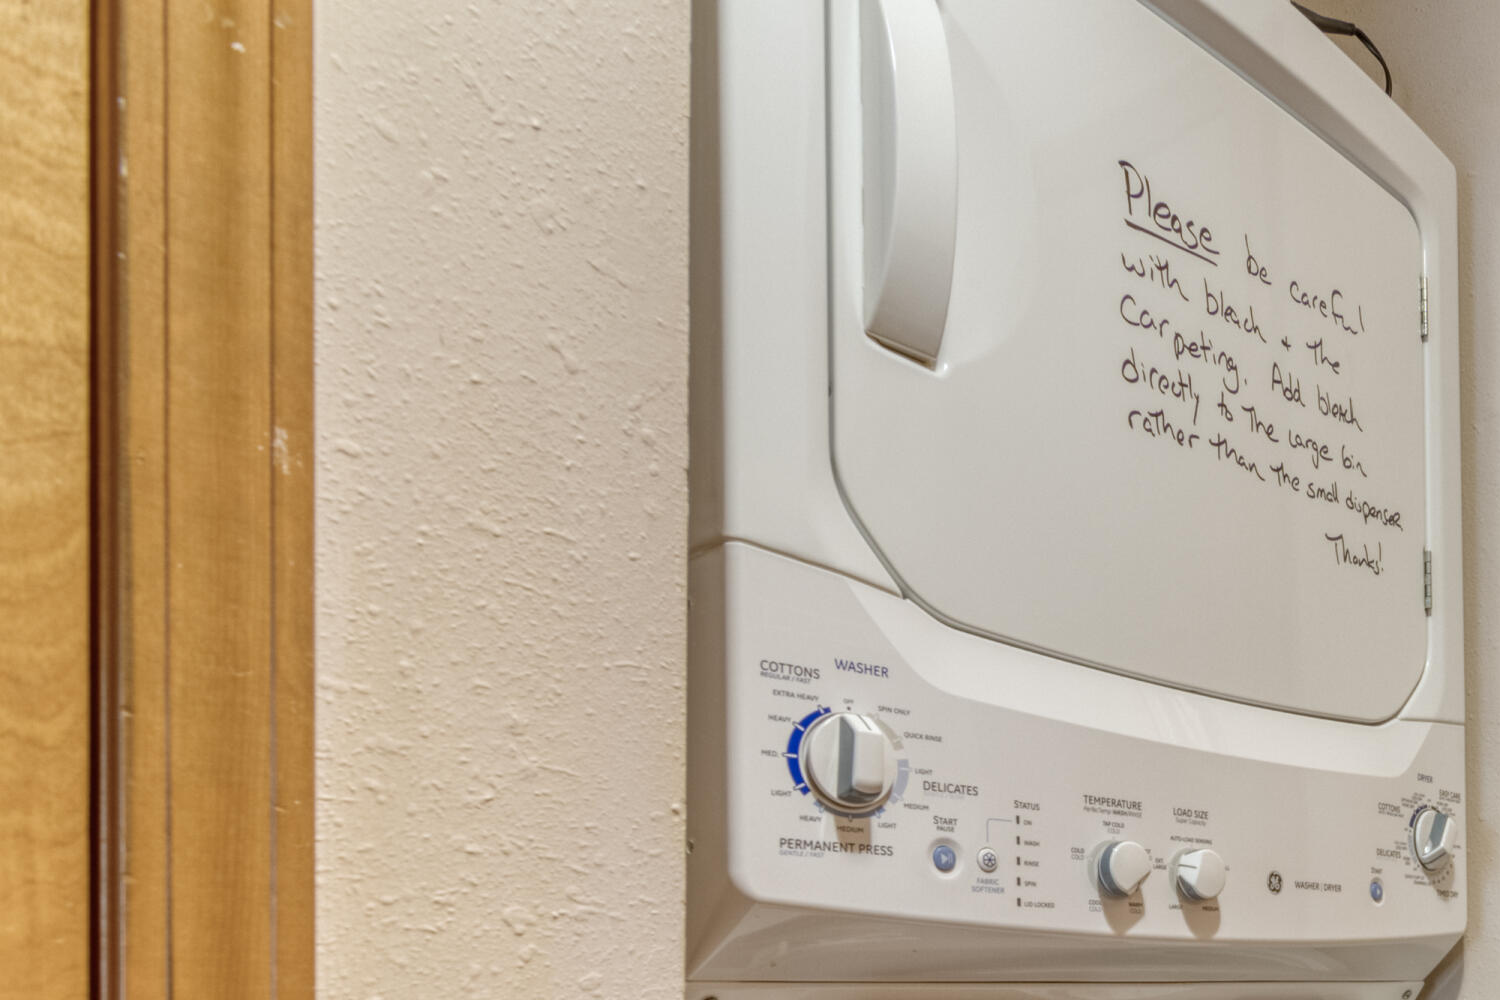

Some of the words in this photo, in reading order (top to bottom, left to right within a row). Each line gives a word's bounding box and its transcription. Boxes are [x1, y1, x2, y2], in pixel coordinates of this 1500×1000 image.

[1118, 160, 1220, 256] Please
[1244, 233, 1272, 285] be
[1290, 281, 1365, 335] careful
[1121, 253, 1189, 302] with
[1204, 278, 1267, 343] bleach
[1271, 362, 1306, 407] Add
[1316, 384, 1363, 432] bleach
[1121, 347, 1199, 425] directly
[1217, 391, 1234, 422] to
[1287, 429, 1333, 469] large
[1341, 445, 1367, 477] bin
[1128, 408, 1200, 448] rather
[1208, 432, 1266, 482] than
[1306, 481, 1339, 504] small
[1324, 532, 1384, 575] Thanks!
[760, 660, 820, 680] COTTONS
[834, 658, 889, 678] WASHER
[760, 671, 790, 681] REGULAR
[772, 689, 795, 698] EXTRA
[797, 691, 819, 701] HEAVY
[878, 705, 892, 713] SPIN
[893, 707, 911, 715] ONLY
[768, 714, 791, 722] HEAVY
[903, 731, 923, 740] QUICK
[925, 734, 942, 742] RINSE
[1417, 772, 1433, 783] DRYER
[923, 780, 979, 796] DELICATES
[1014, 800, 1040, 811] STATUS
[1083, 794, 1142, 811] TEMPERATURE
[1378, 801, 1401, 813] COTTONS
[1173, 808, 1192, 818] LOAD
[1194, 810, 1209, 820] SIZE
[836, 825, 864, 833] MEDIUM
[779, 838, 856, 853] PERMANENT
[858, 843, 894, 857] PRESS
[976, 877, 999, 885] FABRIC
[1294, 880, 1320, 891] WASHER
[1323, 883, 1342, 892] DRYER
[971, 886, 1005, 894] SOFTENER
